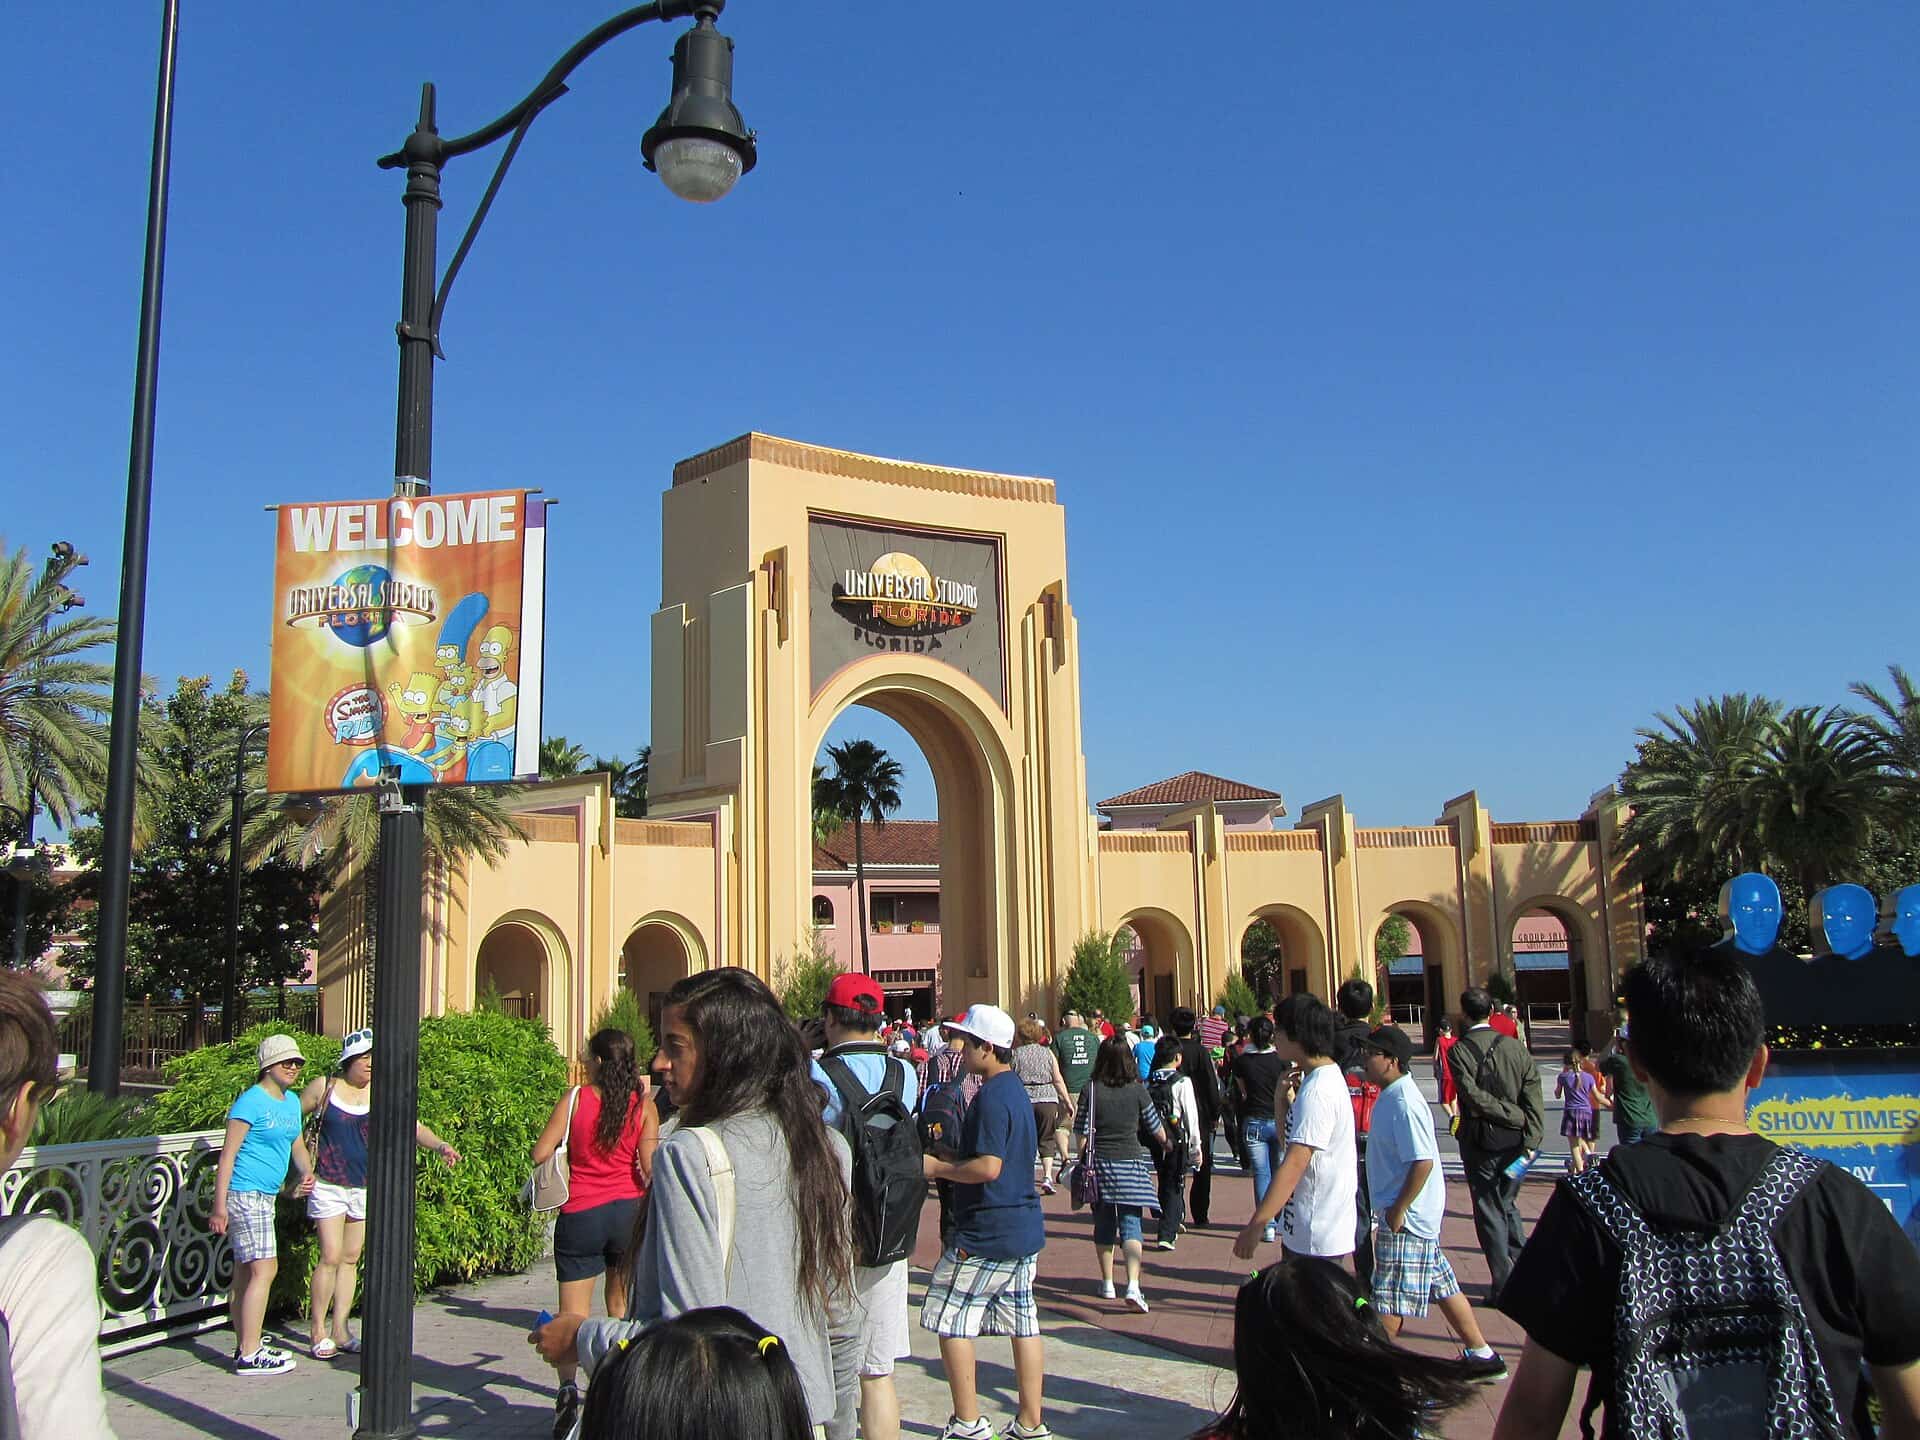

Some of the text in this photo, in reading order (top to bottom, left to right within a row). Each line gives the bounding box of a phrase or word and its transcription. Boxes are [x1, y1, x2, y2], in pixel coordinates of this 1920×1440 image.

[290, 496, 517, 552] WELCOME
[289, 582, 375, 616] UNIVERSAL
[844, 569, 978, 609] UNIVERSAL STUDIOS
[872, 604, 962, 625] FLORIDA
[335, 716, 381, 744] RID
[1757, 1109, 1919, 1132] SHOW TIMES
